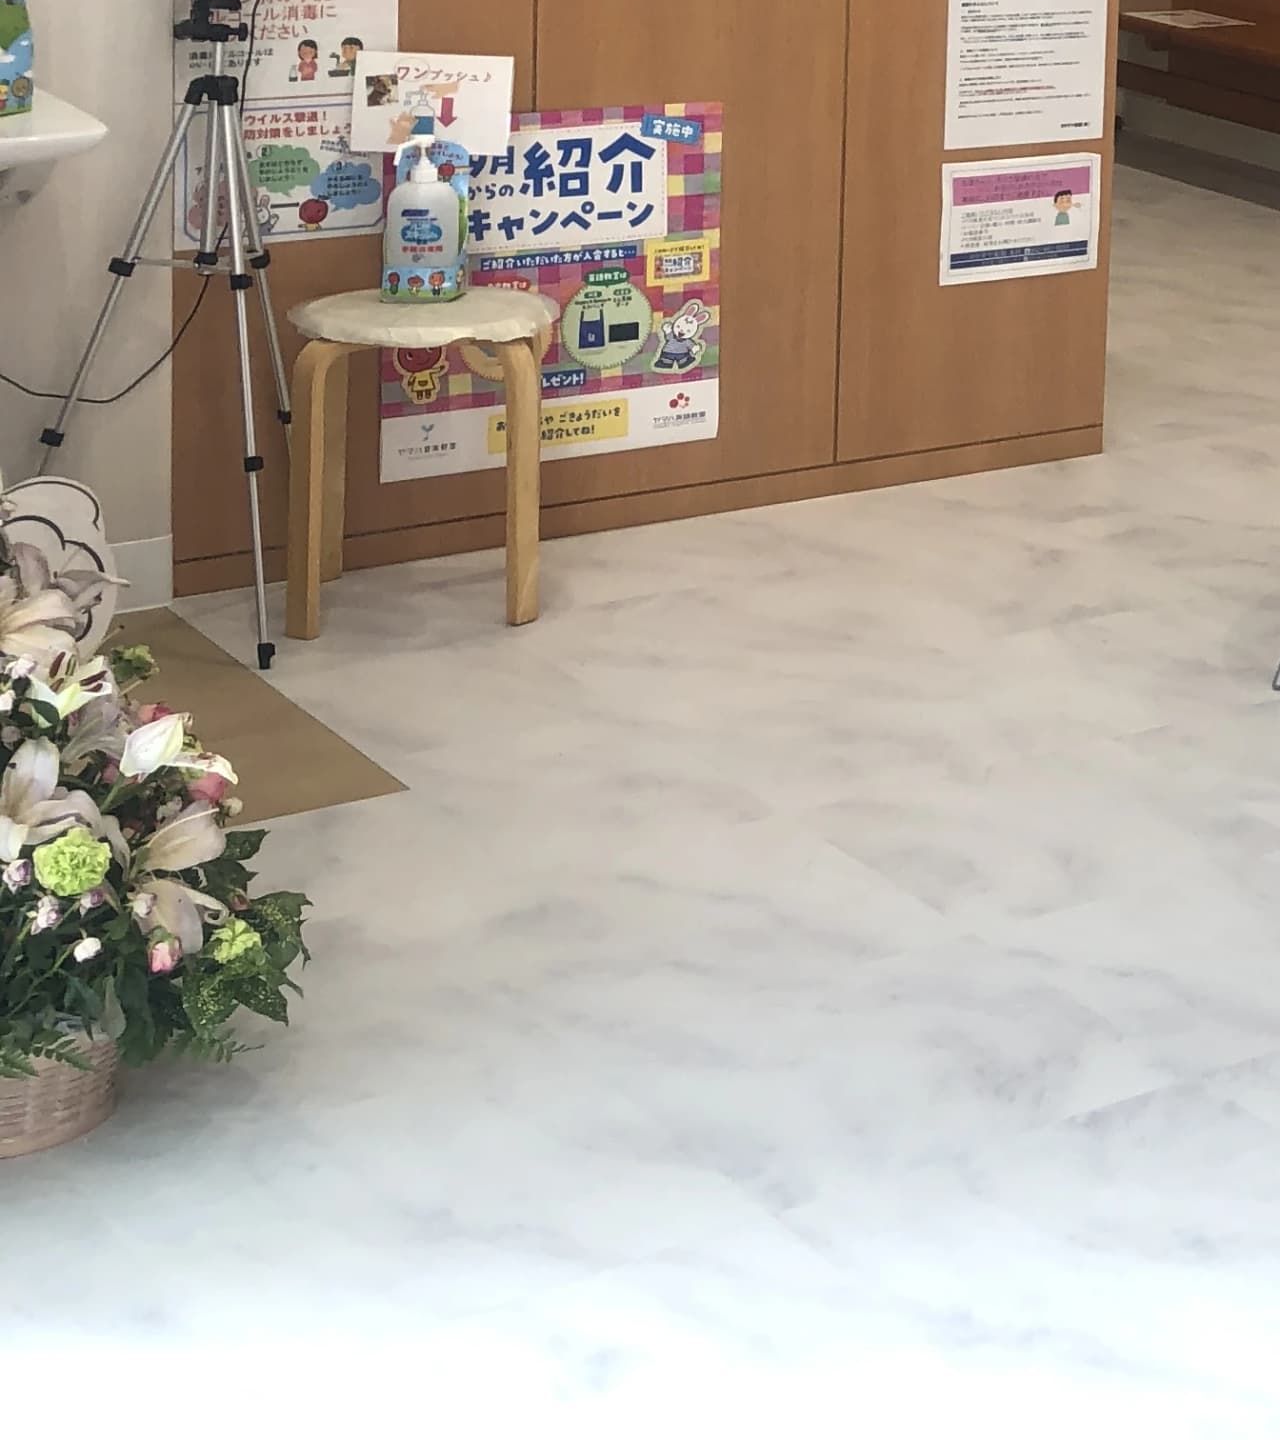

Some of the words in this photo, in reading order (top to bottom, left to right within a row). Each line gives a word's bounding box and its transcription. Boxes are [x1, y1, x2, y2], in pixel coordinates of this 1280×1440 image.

[651, 119, 694, 139] 実施中
[519, 132, 656, 198] 紹介
[468, 201, 654, 241] キャンペーン
[541, 372, 584, 388] レゼント！
